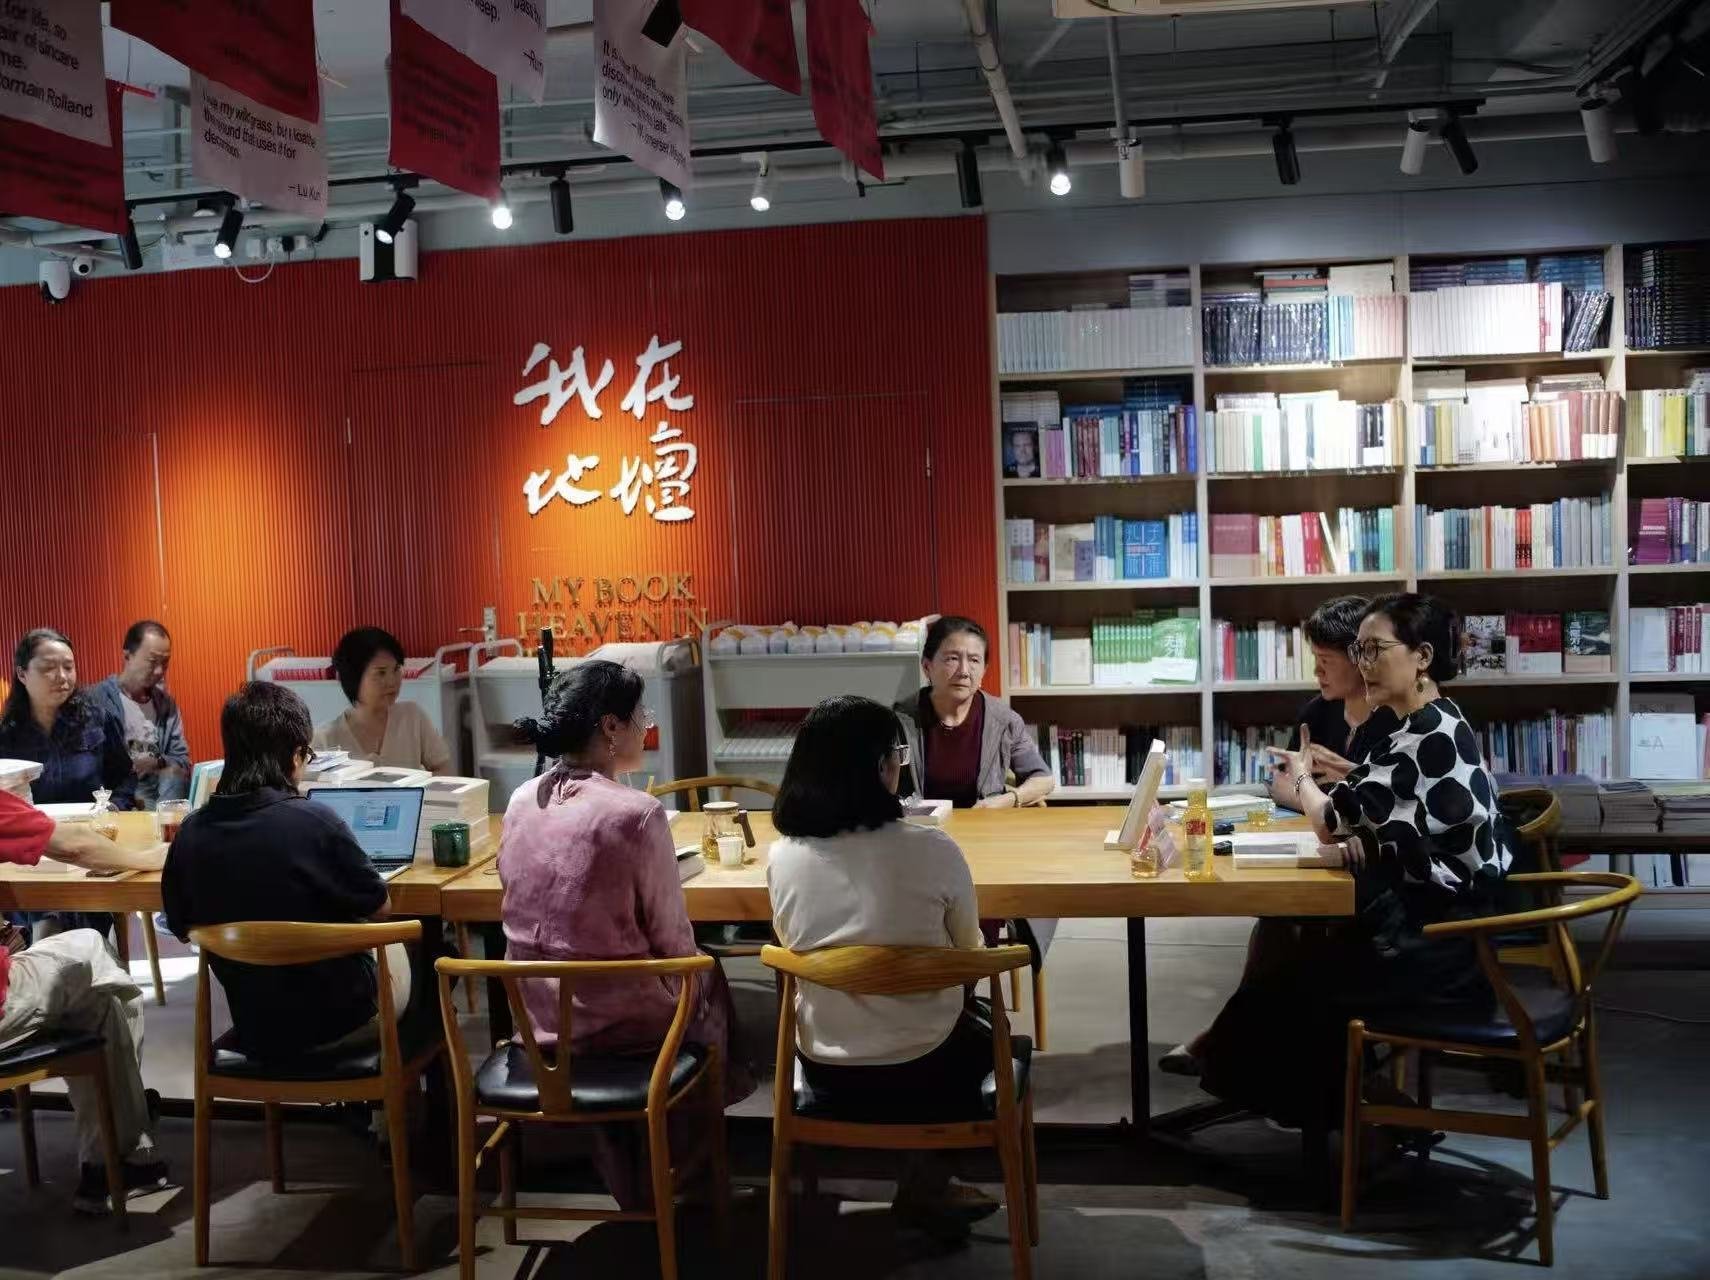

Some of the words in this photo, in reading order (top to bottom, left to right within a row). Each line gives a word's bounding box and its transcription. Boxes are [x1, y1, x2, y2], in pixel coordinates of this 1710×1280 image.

[0, 74, 45, 102] omain
[47, 87, 94, 119] Rolland
[220, 101, 234, 120] my
[602, 85, 621, 107] only
[513, 334, 694, 426] 我在
[531, 575, 584, 604] MY
[593, 572, 697, 603] BOOK
[518, 609, 662, 641] HEAVEN
[673, 606, 709, 638] IN
